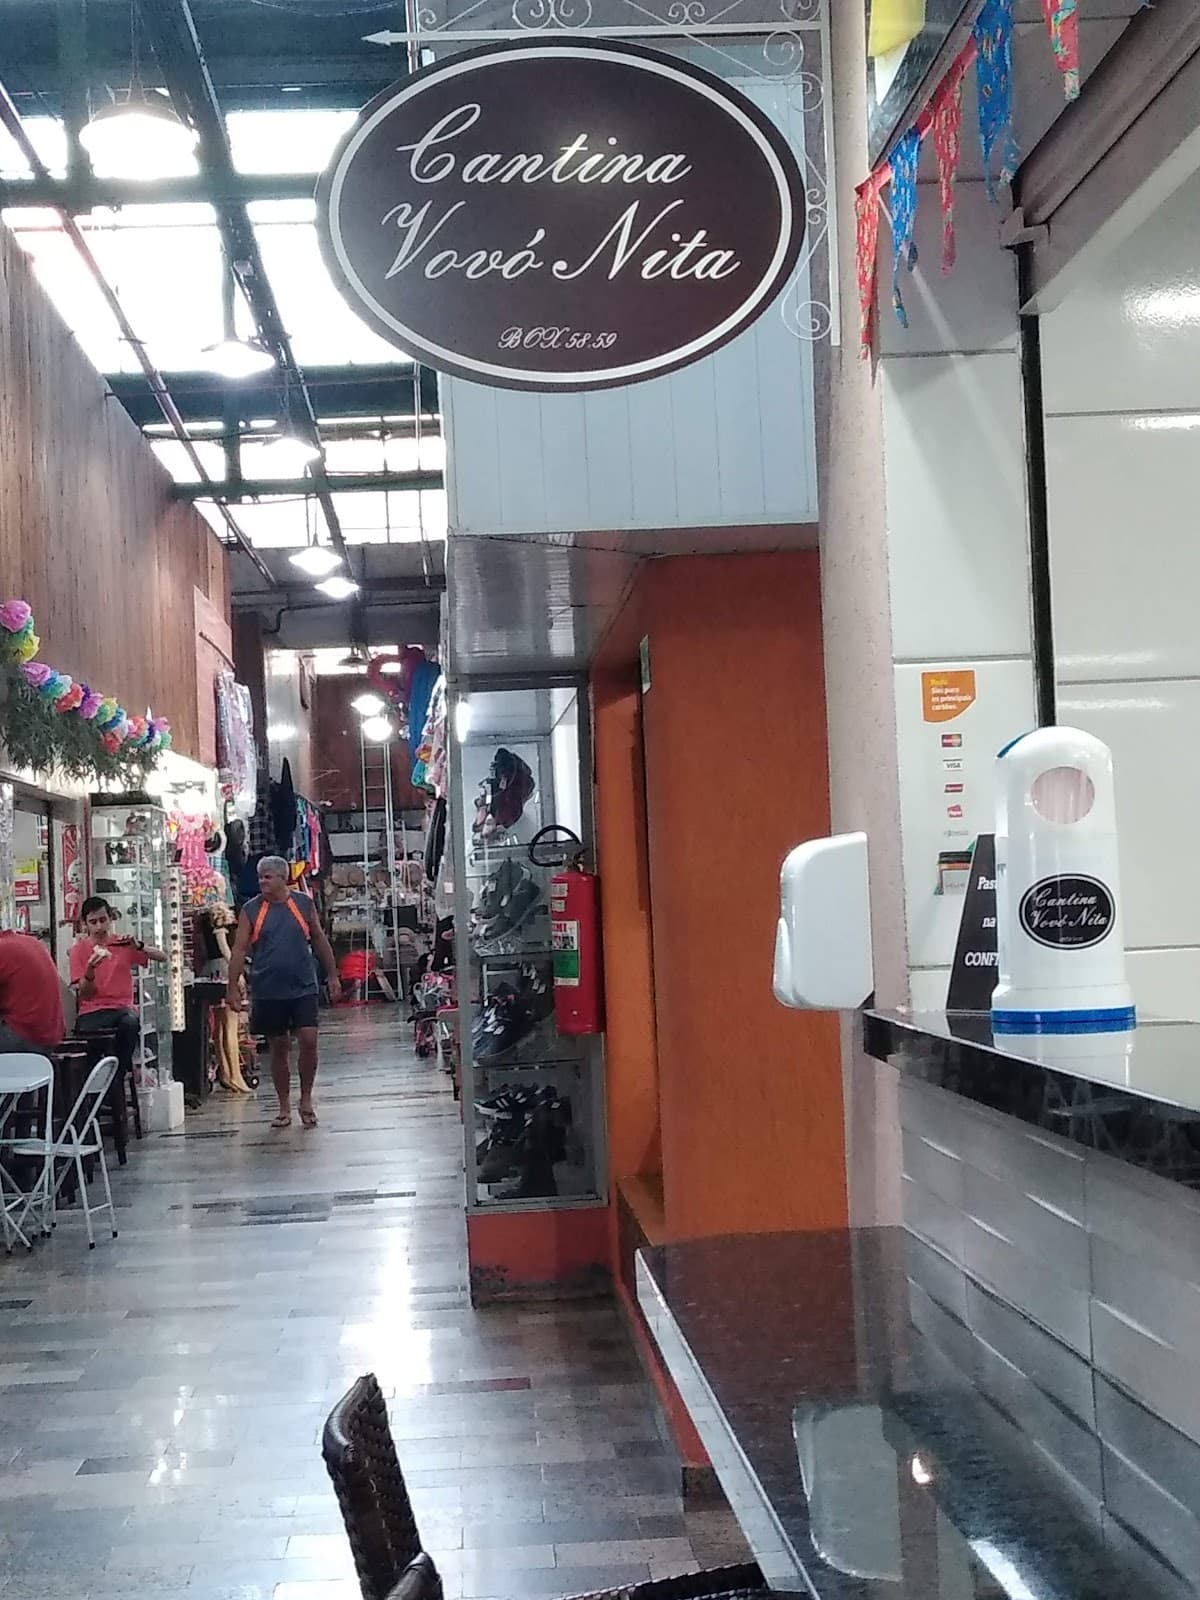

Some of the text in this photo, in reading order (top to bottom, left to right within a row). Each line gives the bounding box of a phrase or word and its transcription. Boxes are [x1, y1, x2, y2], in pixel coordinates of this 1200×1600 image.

[396, 102, 693, 184] Cantina
[381, 199, 742, 281] Vovó Nita
[498, 326, 570, 349] BOX
[1033, 887, 1097, 907] Cantina
[1067, 906, 1107, 927] Nita
